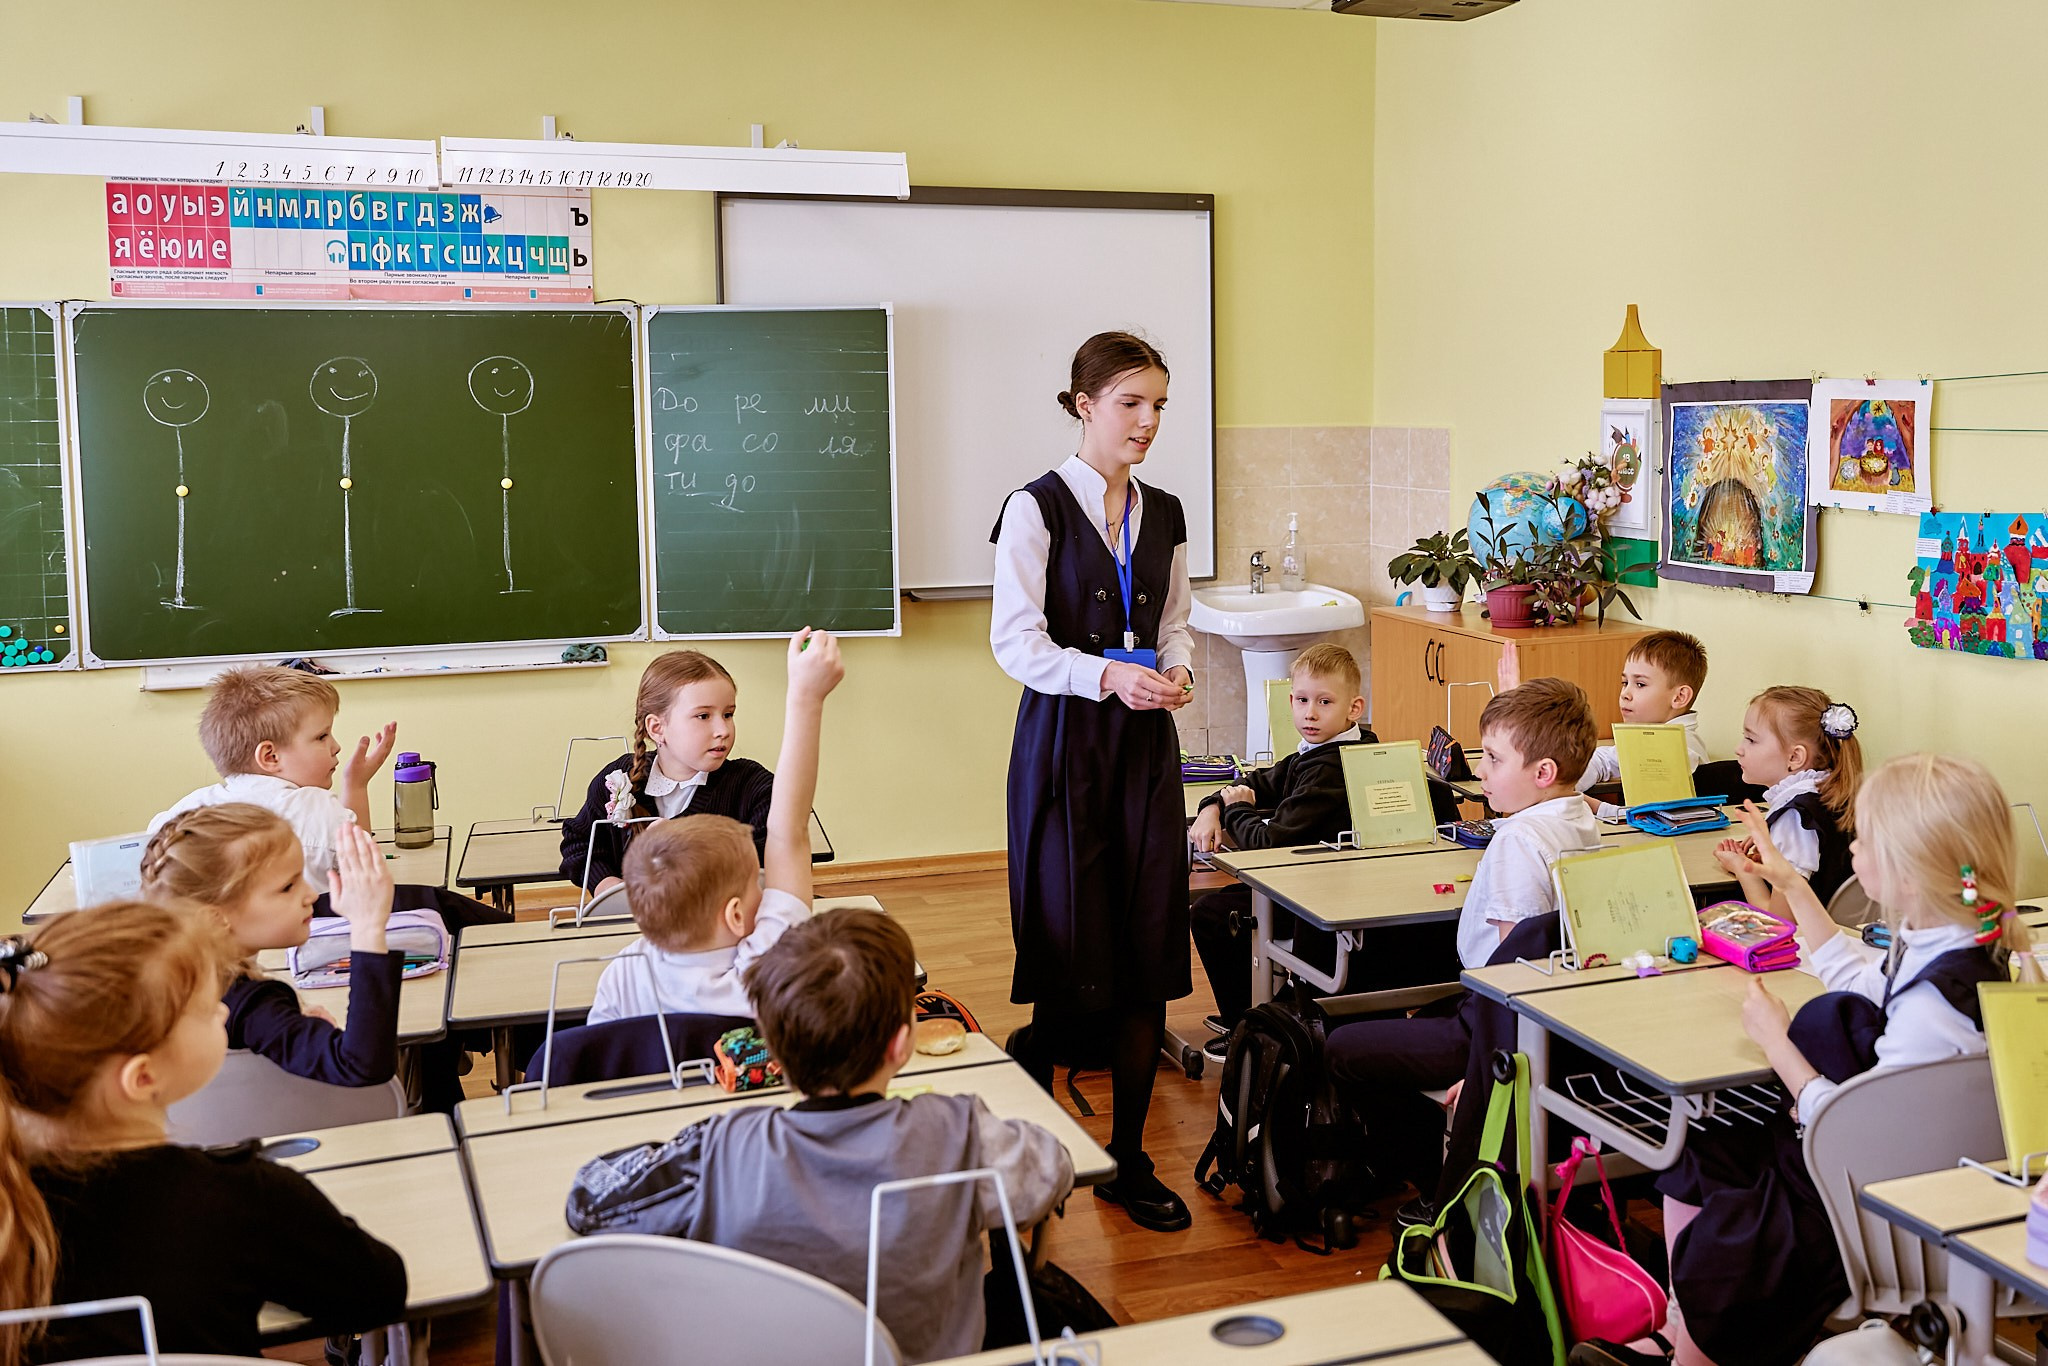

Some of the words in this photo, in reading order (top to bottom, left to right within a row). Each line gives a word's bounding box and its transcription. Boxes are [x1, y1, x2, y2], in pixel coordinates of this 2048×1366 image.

[216, 161, 224, 176] 1
[238, 162, 247, 178] 2
[260, 163, 269, 178] 3
[282, 165, 292, 180] 4
[303, 166, 312, 180] 5
[324, 166, 335, 180] 6
[346, 166, 354, 181] 7
[366, 168, 376, 183] 8
[388, 168, 398, 183] 9
[406, 169, 424, 184] 10
[458, 167, 473, 182] 11
[478, 168, 494, 183] 12
[499, 169, 513, 184] 13
[519, 169, 533, 184] 14
[538, 170, 553, 185] 15
[558, 170, 574, 185] 16
[578, 170, 593, 185] 17
[598, 172, 612, 186] 18
[617, 172, 632, 186] 19
[636, 173, 653, 187] 20
[112, 193, 128, 214] а
[136, 193, 152, 215] о
[162, 194, 176, 222] у
[184, 195, 204, 216] ы
[210, 196, 224, 217] э
[234, 190, 249, 217] й
[258, 198, 272, 218] н
[279, 199, 299, 218] м
[304, 199, 320, 219] л
[328, 200, 343, 227] р
[349, 193, 365, 221] б
[373, 201, 388, 221] в
[397, 201, 408, 221] г
[417, 202, 435, 227] д
[441, 203, 455, 222] з
[461, 203, 479, 223] ж
[570, 208, 588, 226] ъ
[114, 237, 130, 258] я
[139, 230, 154, 259] ё
[161, 238, 182, 259] ю
[188, 239, 203, 259] и
[212, 239, 226, 259] е
[352, 242, 367, 262] п
[372, 236, 391, 269] ф
[397, 243, 411, 263] к
[420, 244, 434, 264] т
[443, 245, 455, 264] с
[462, 245, 481, 265] ш
[487, 246, 500, 265] х
[508, 247, 523, 270] ц
[530, 247, 544, 266] ч
[550, 247, 568, 271] щ
[574, 249, 588, 267] ь
[652, 387, 698, 412] До
[735, 394, 767, 424] ре
[665, 433, 712, 464] фа
[743, 432, 778, 453] со
[664, 472, 696, 490] ти
